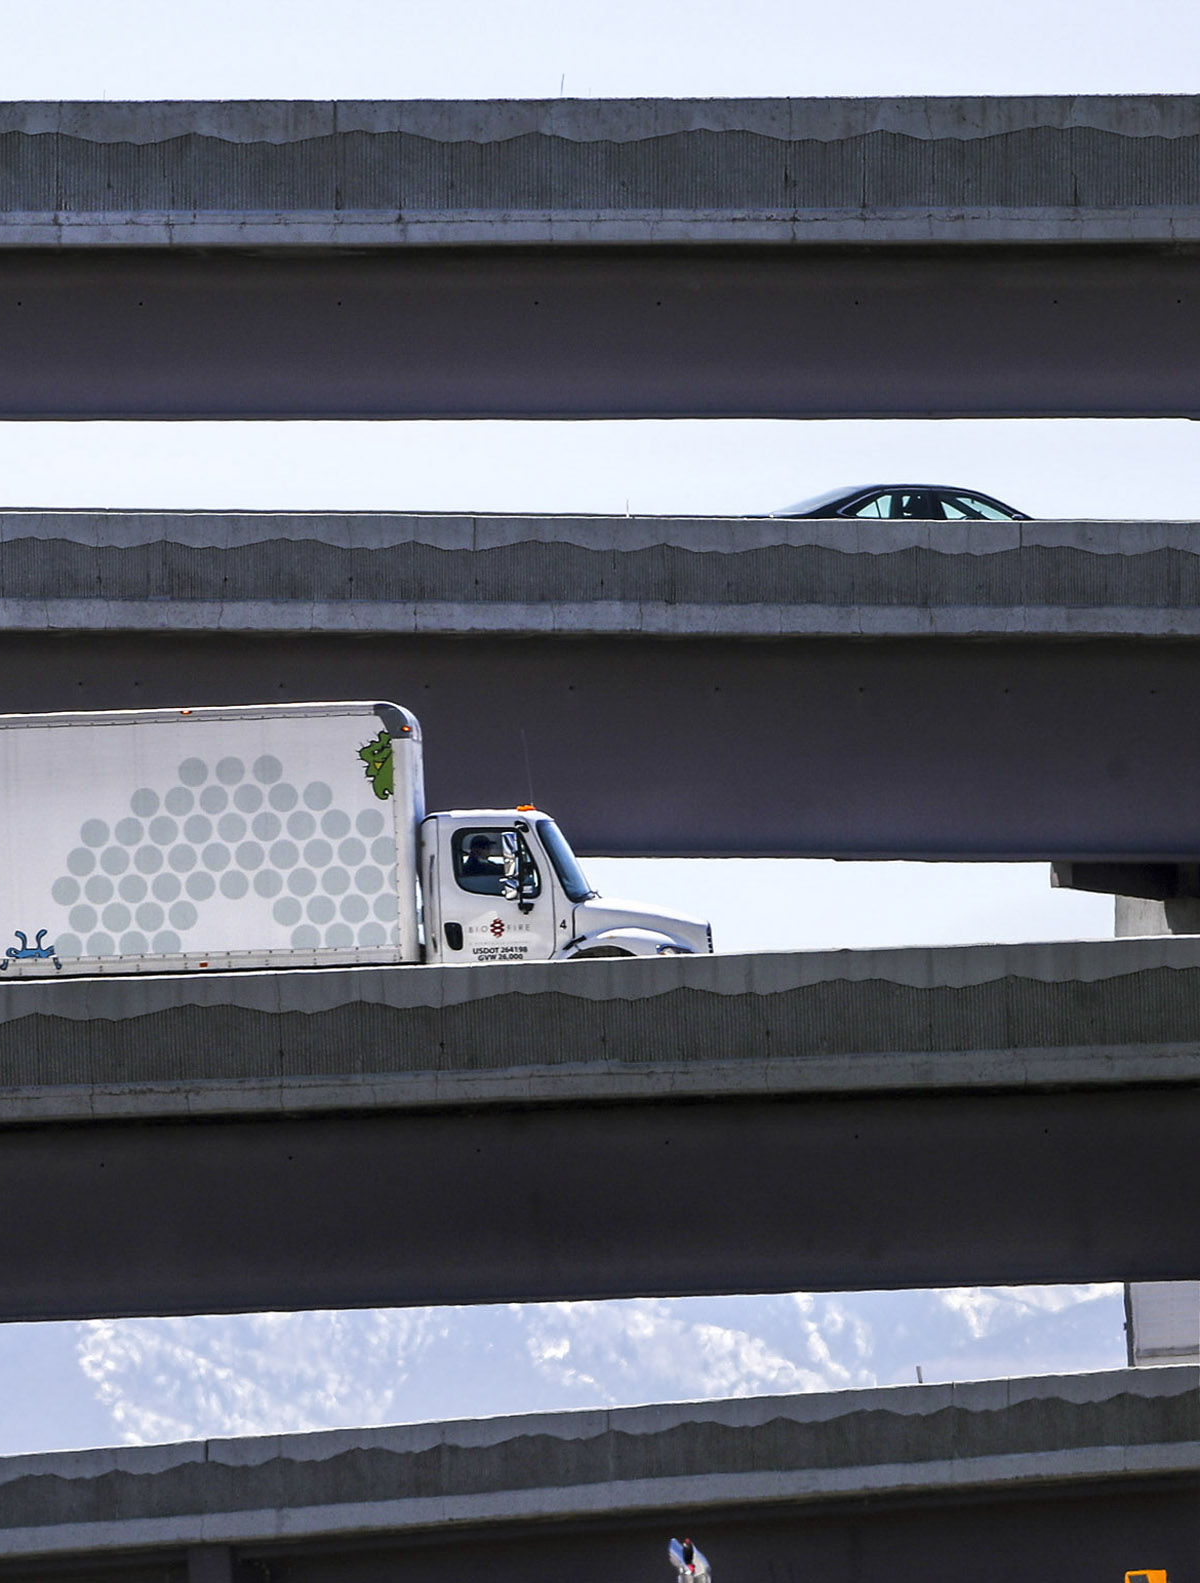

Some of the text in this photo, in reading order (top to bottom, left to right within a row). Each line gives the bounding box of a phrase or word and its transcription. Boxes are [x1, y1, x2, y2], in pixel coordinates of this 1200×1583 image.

[468, 923, 531, 934] BIO FIRE
[559, 919, 567, 930] 4
[472, 947, 499, 955] USDOT
[498, 953, 523, 961] 26,000
